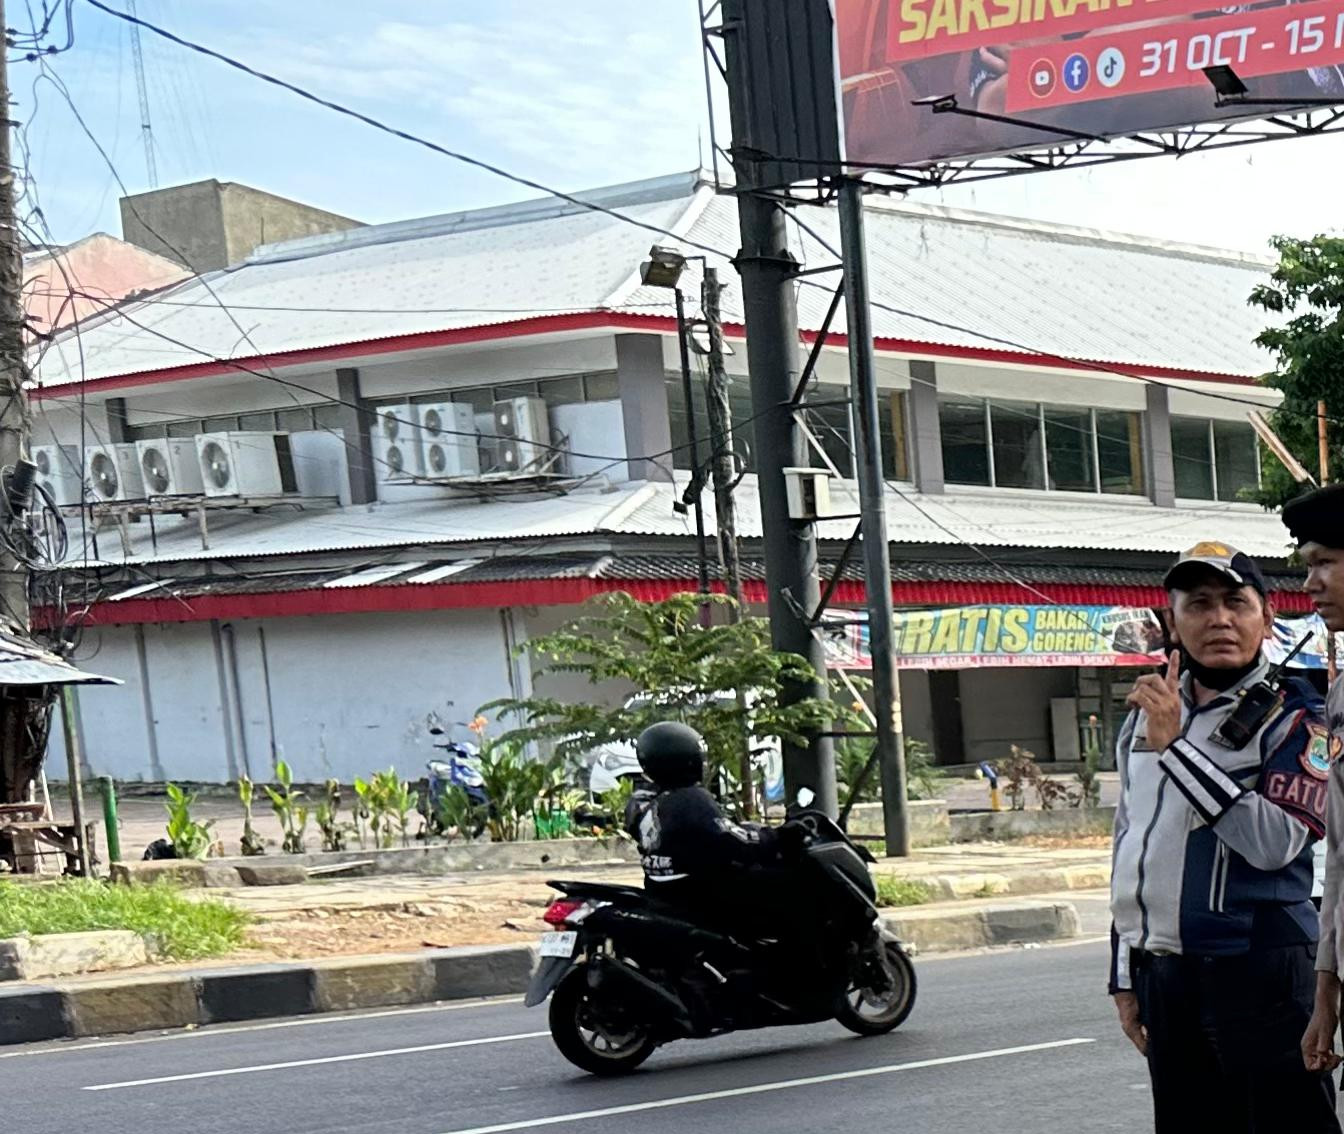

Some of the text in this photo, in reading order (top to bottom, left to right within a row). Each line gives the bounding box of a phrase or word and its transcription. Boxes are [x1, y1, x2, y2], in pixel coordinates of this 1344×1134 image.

[1140, 39, 1177, 77] 31
[1186, 27, 1257, 71] OCT
[1285, 16, 1325, 55] 15
[893, 608, 1034, 654] RATIS
[1033, 631, 1096, 653] GORENG
